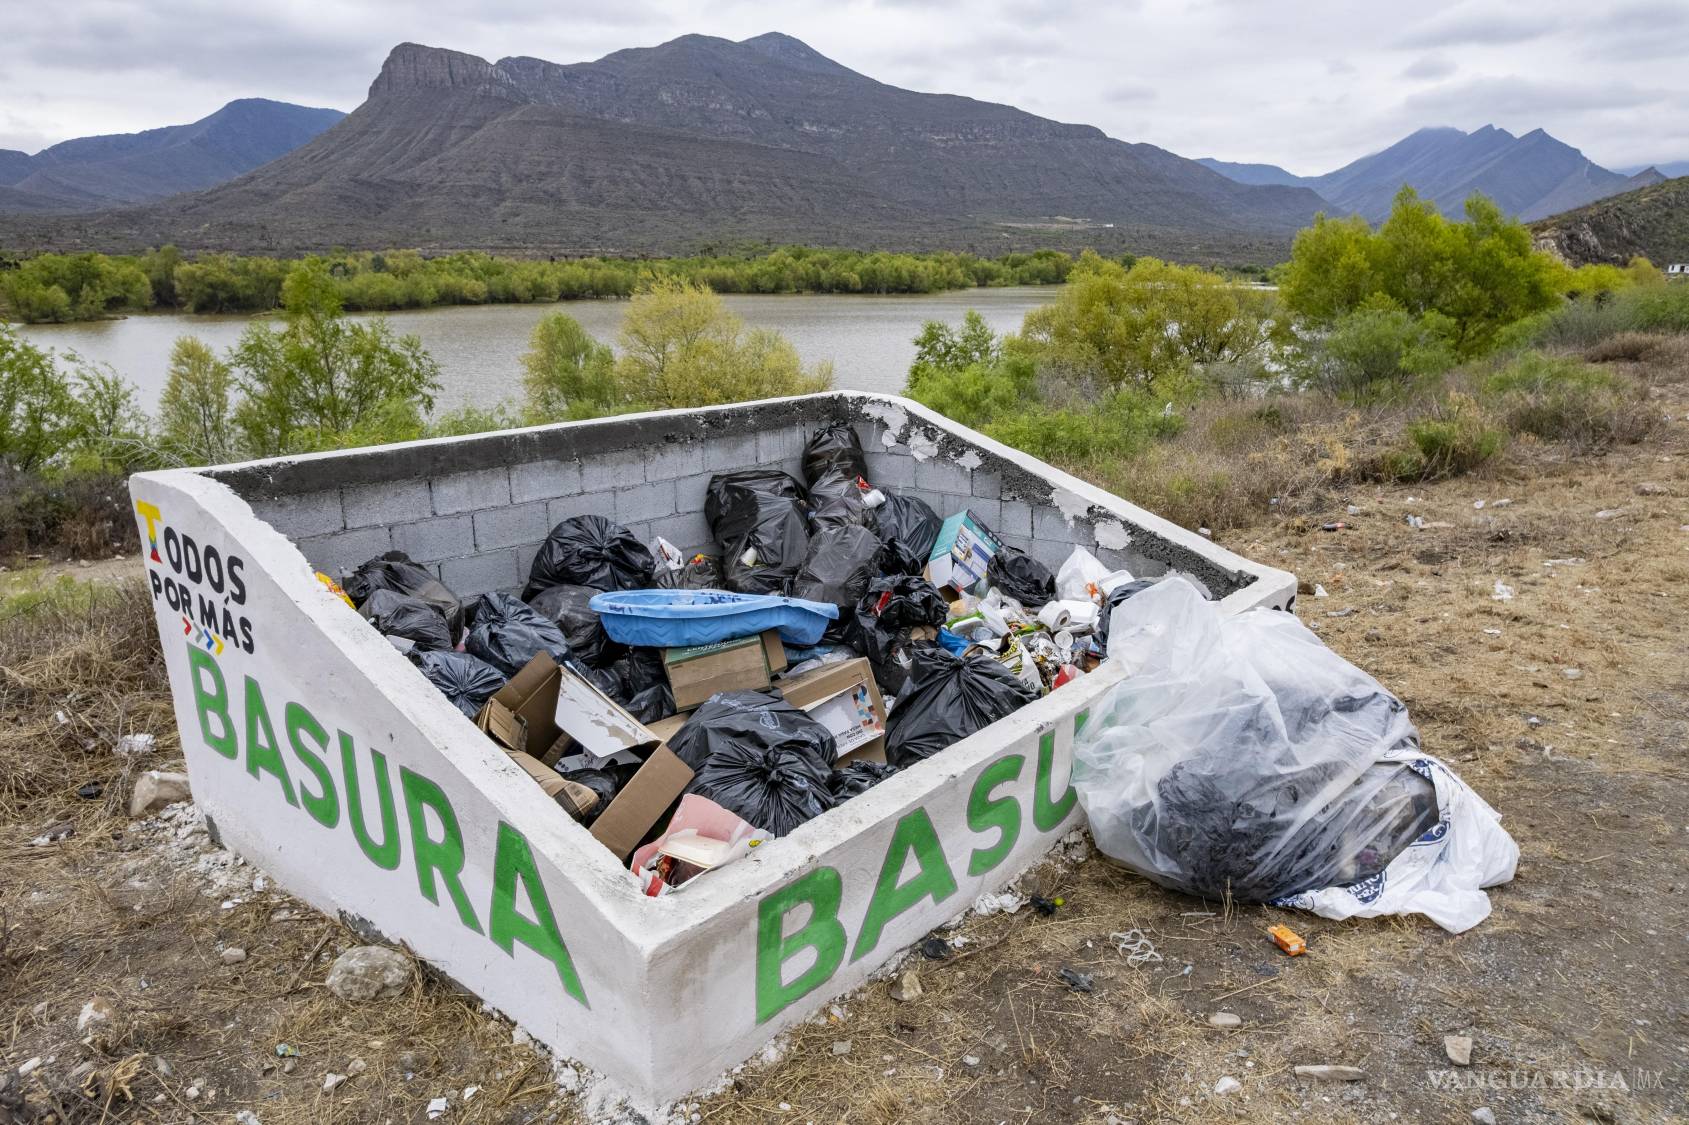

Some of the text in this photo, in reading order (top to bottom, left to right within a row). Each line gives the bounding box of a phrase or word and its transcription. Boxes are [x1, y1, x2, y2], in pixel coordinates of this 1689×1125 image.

[136, 499, 247, 606] TODOS
[149, 568, 255, 655] POR MÁS
[187, 642, 591, 1011] BASURA
[755, 707, 1092, 1026] BASU
